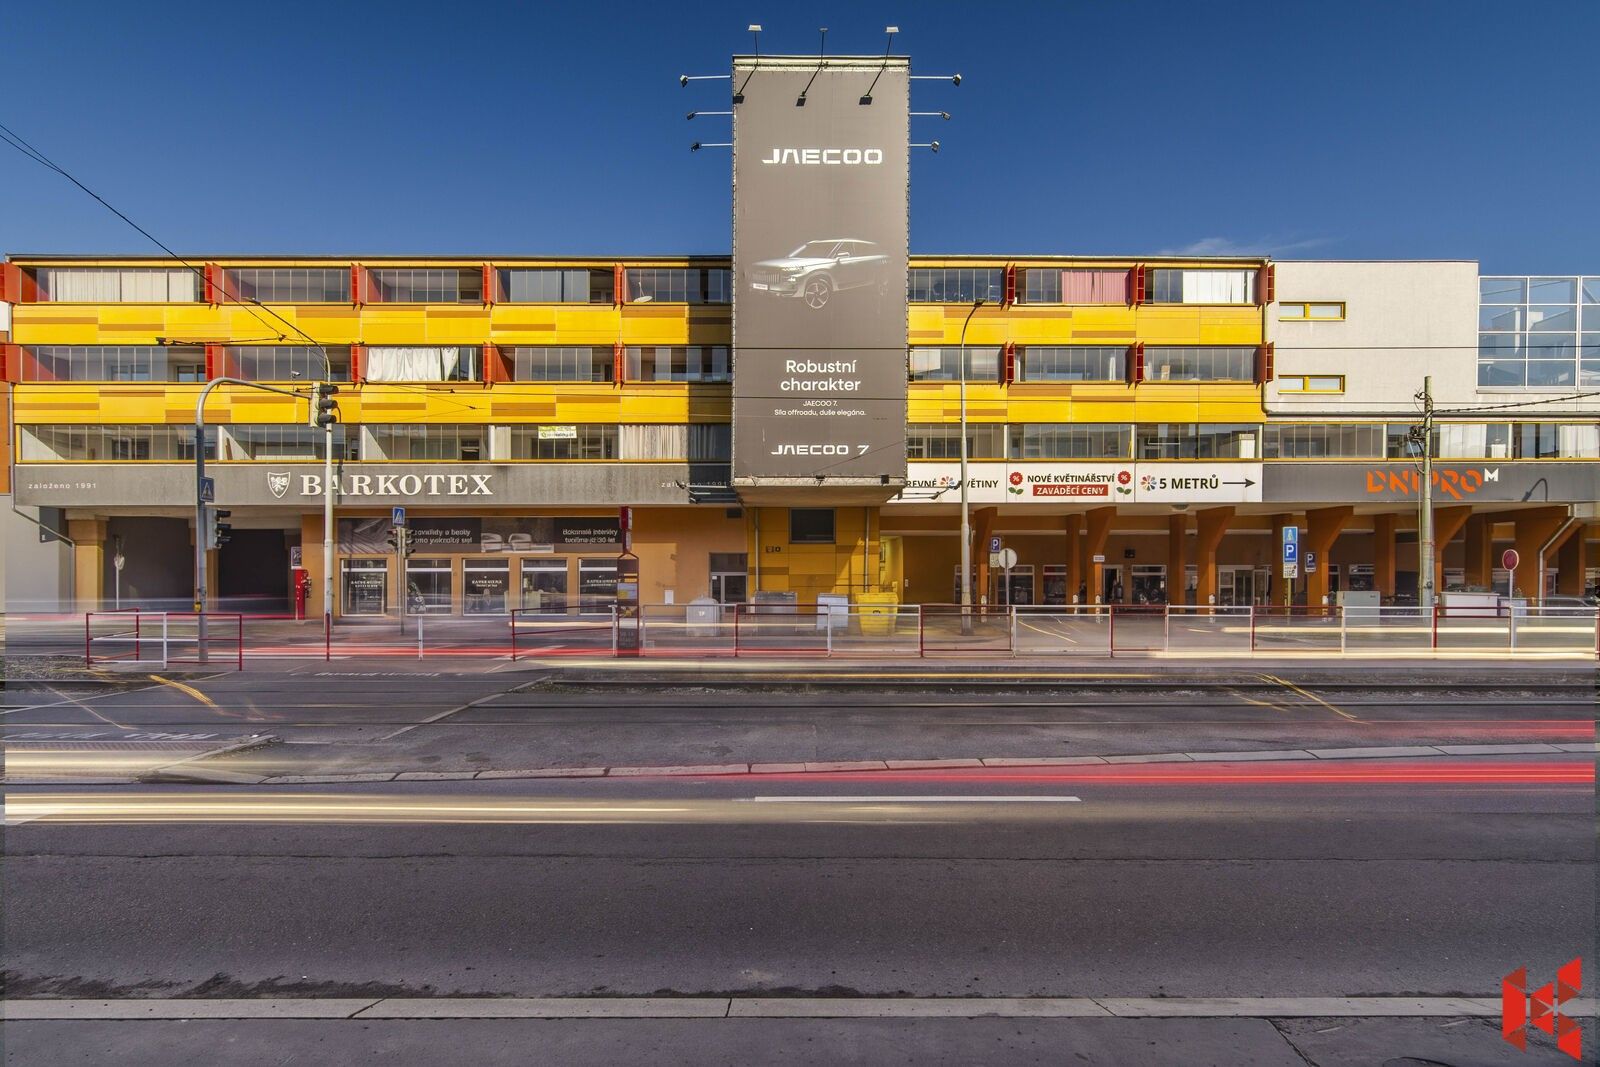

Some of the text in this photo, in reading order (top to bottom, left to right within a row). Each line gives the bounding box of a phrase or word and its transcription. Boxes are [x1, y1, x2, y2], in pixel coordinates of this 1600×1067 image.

[761, 148, 883, 165] JAECOO
[786, 359, 857, 373] Robustní
[780, 378, 861, 391] charakter
[770, 444, 870, 455] JAECOO 7
[1027, 473, 1115, 483] NOVÉ KVĚTINÁŘSTVÍ
[1159, 474, 1219, 489] 5 METRŮ
[300, 474, 493, 496] BARKOTEX
[1036, 485, 1104, 495] ZAVÁDĚCÍ CENY
[1286, 544, 1295, 557] P
